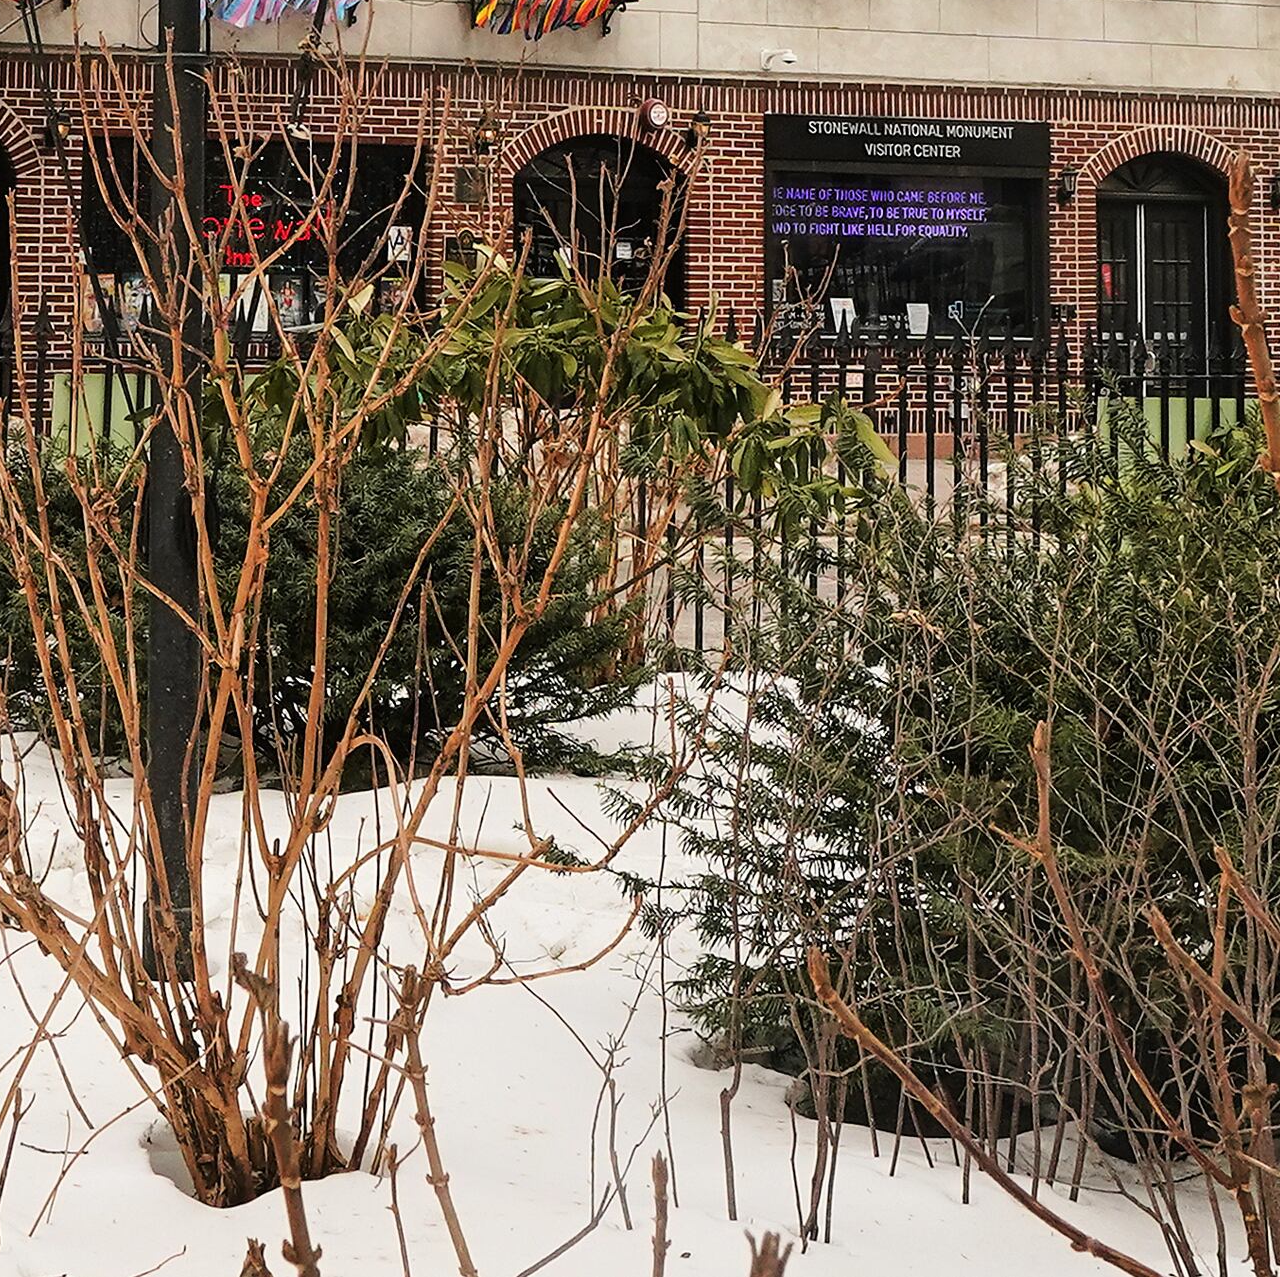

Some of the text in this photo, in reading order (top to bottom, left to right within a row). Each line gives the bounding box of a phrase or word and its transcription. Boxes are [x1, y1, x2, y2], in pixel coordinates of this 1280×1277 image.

[808, 120, 1014, 140] STONEWALL NATIONAL MONUMENT
[864, 143, 961, 158] VISITOR CENTER
[786, 187, 816, 201] NAME
[819, 188, 833, 201] OF
[834, 188, 869, 202] THOSE
[870, 190, 895, 203] WHO
[897, 190, 925, 203] CAME
[927, 191, 967, 204] BEFORE
[798, 205, 813, 218] TO
[815, 205, 829, 218] BE
[831, 205, 869, 220] BRAVE,
[869, 206, 884, 219] TO
[886, 206, 900, 219] BE
[902, 207, 929, 220] TRUE
[930, 208, 944, 221] TO
[946, 208, 987, 222] MYSELF,
[793, 223, 807, 235] TO
[809, 223, 840, 236] FIGHT
[841, 223, 865, 236] LIKE
[867, 223, 894, 237] HELL
[895, 224, 917, 237] FOR
